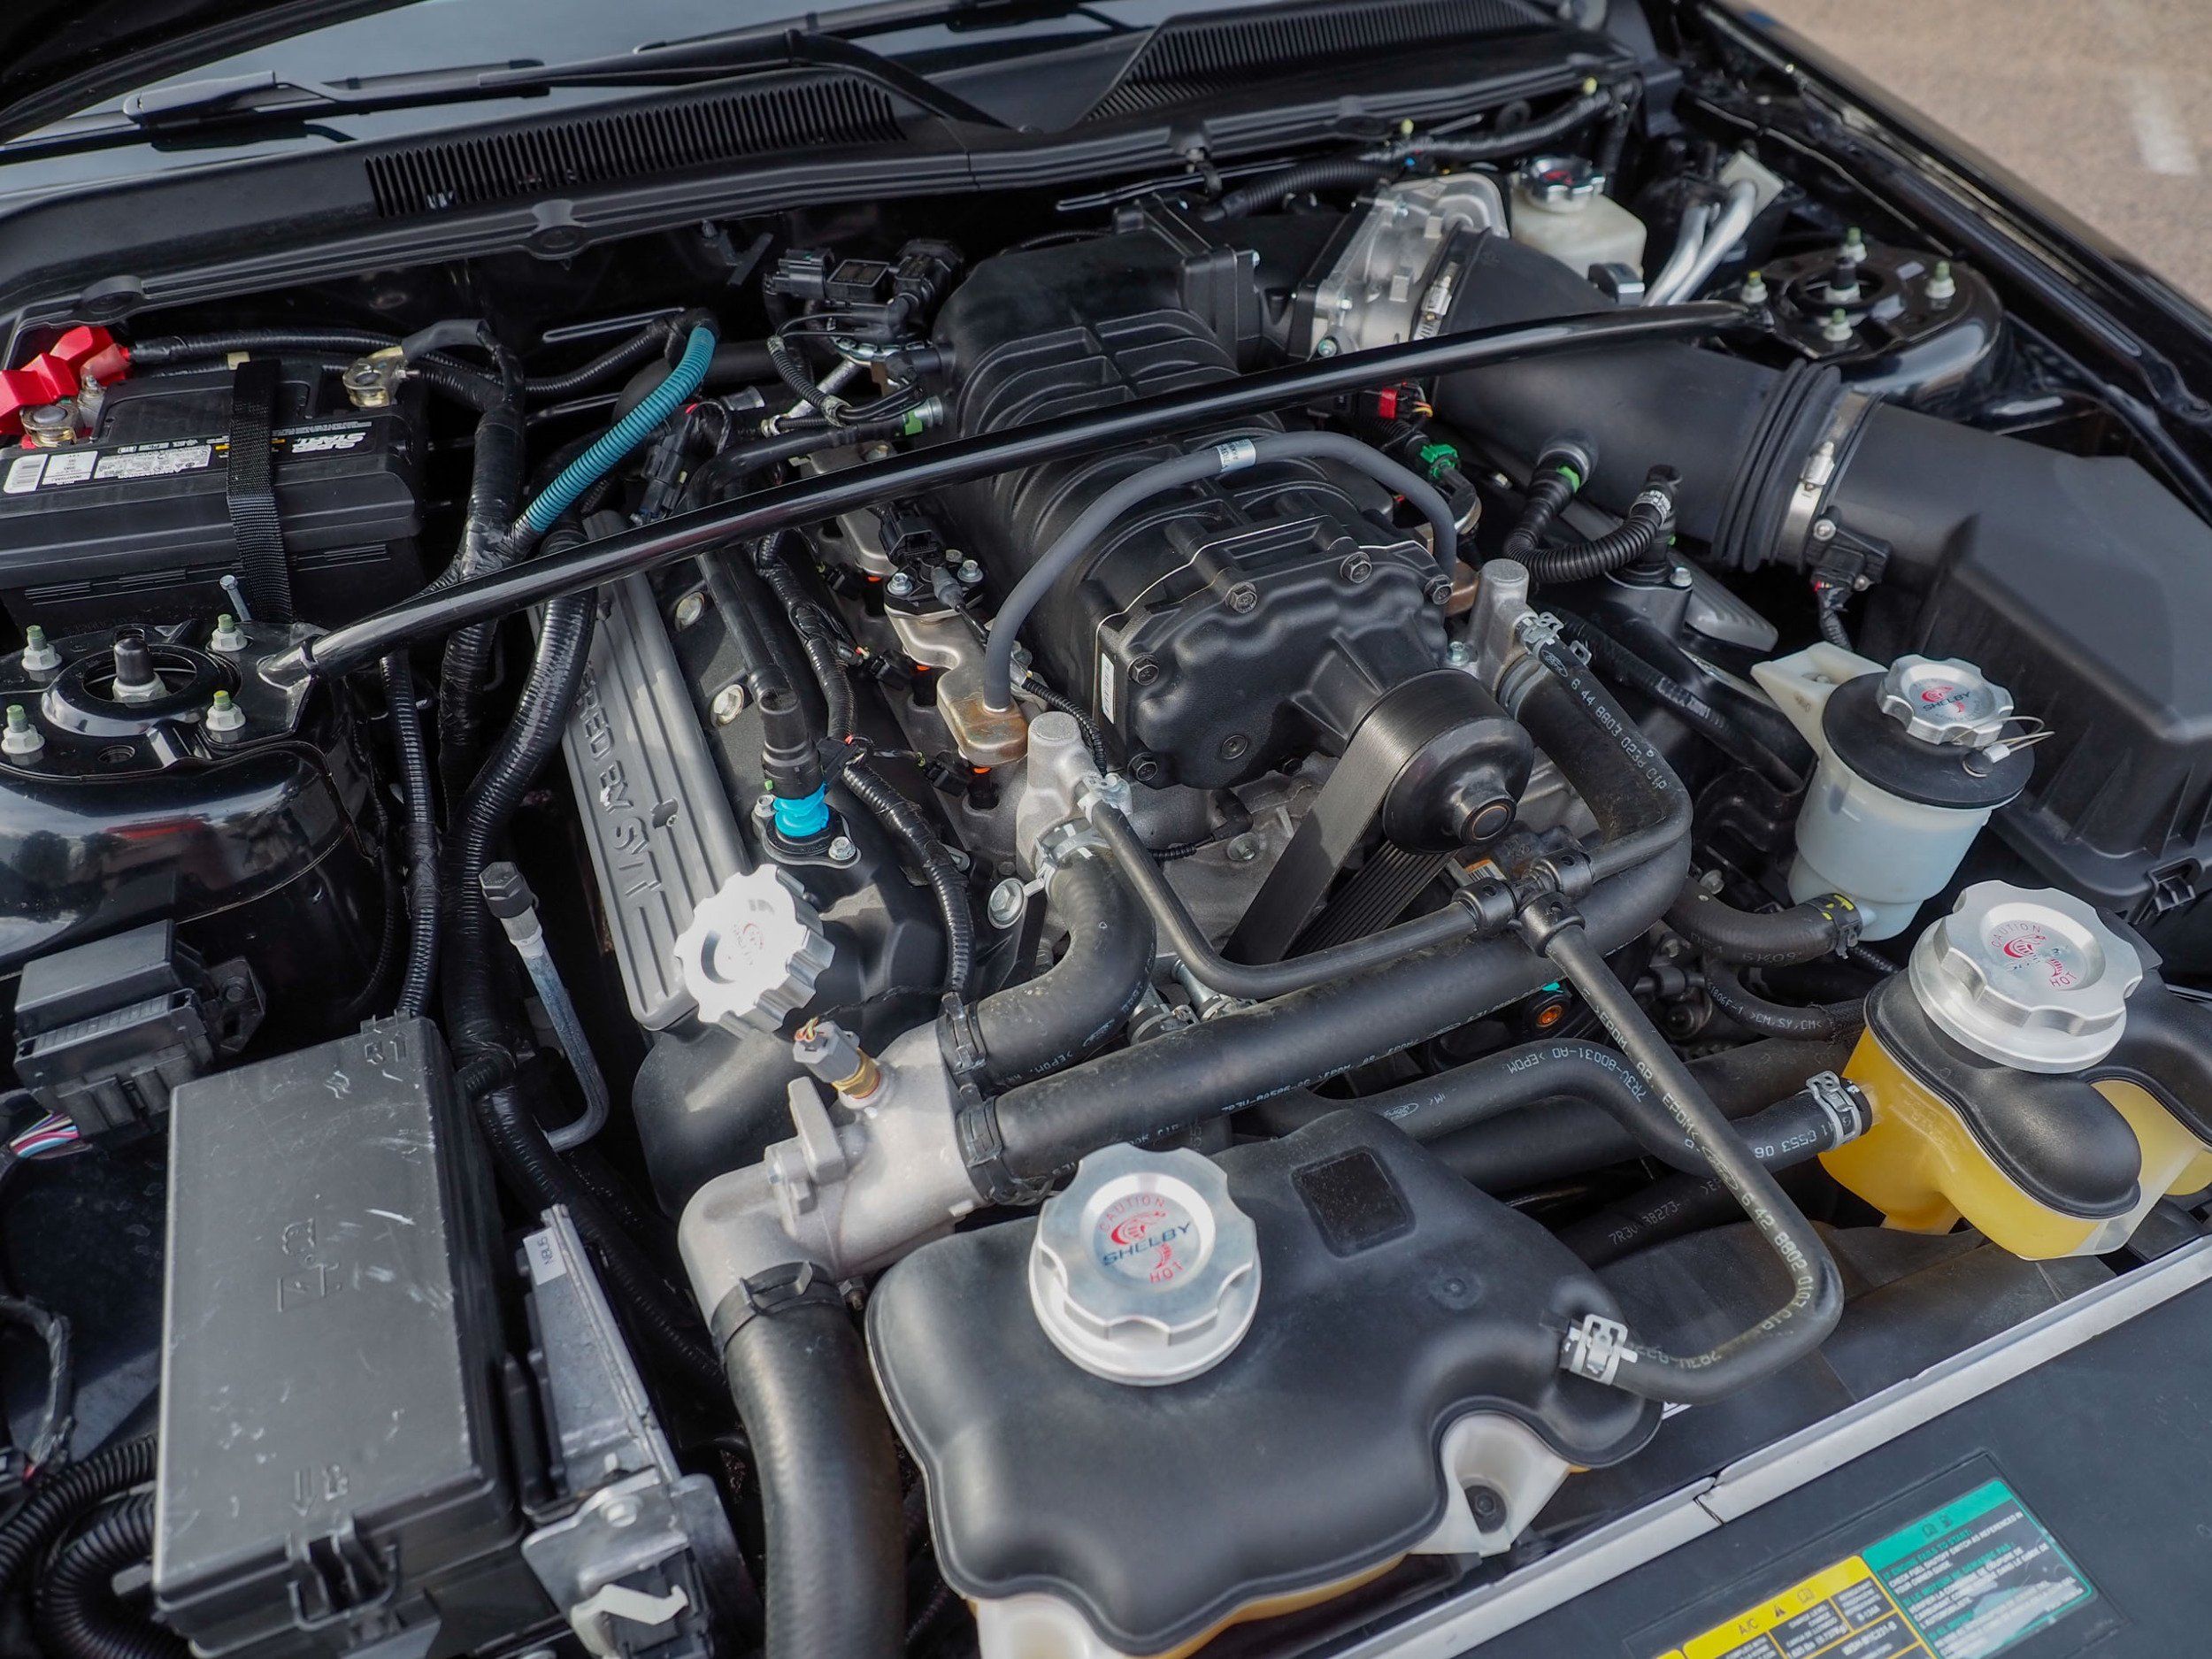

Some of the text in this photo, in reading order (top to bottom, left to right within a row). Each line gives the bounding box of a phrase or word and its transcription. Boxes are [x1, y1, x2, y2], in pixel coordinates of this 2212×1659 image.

[1571, 678, 1581, 690] 6
[1581, 690, 1596, 706] 44
[1923, 691, 1970, 711] SHELBY
[1991, 923, 2041, 948] CAUTION
[2049, 972, 2078, 987] HOT
[1099, 1194, 1166, 1232] CAUTION
[1102, 1221, 1191, 1266] SHELBY
[1755, 1208, 1776, 1231] 42
[1774, 1231, 1809, 1271] 8802
[1149, 1261, 1184, 1284] HOT
[1735, 1616, 1760, 1637] A/C
